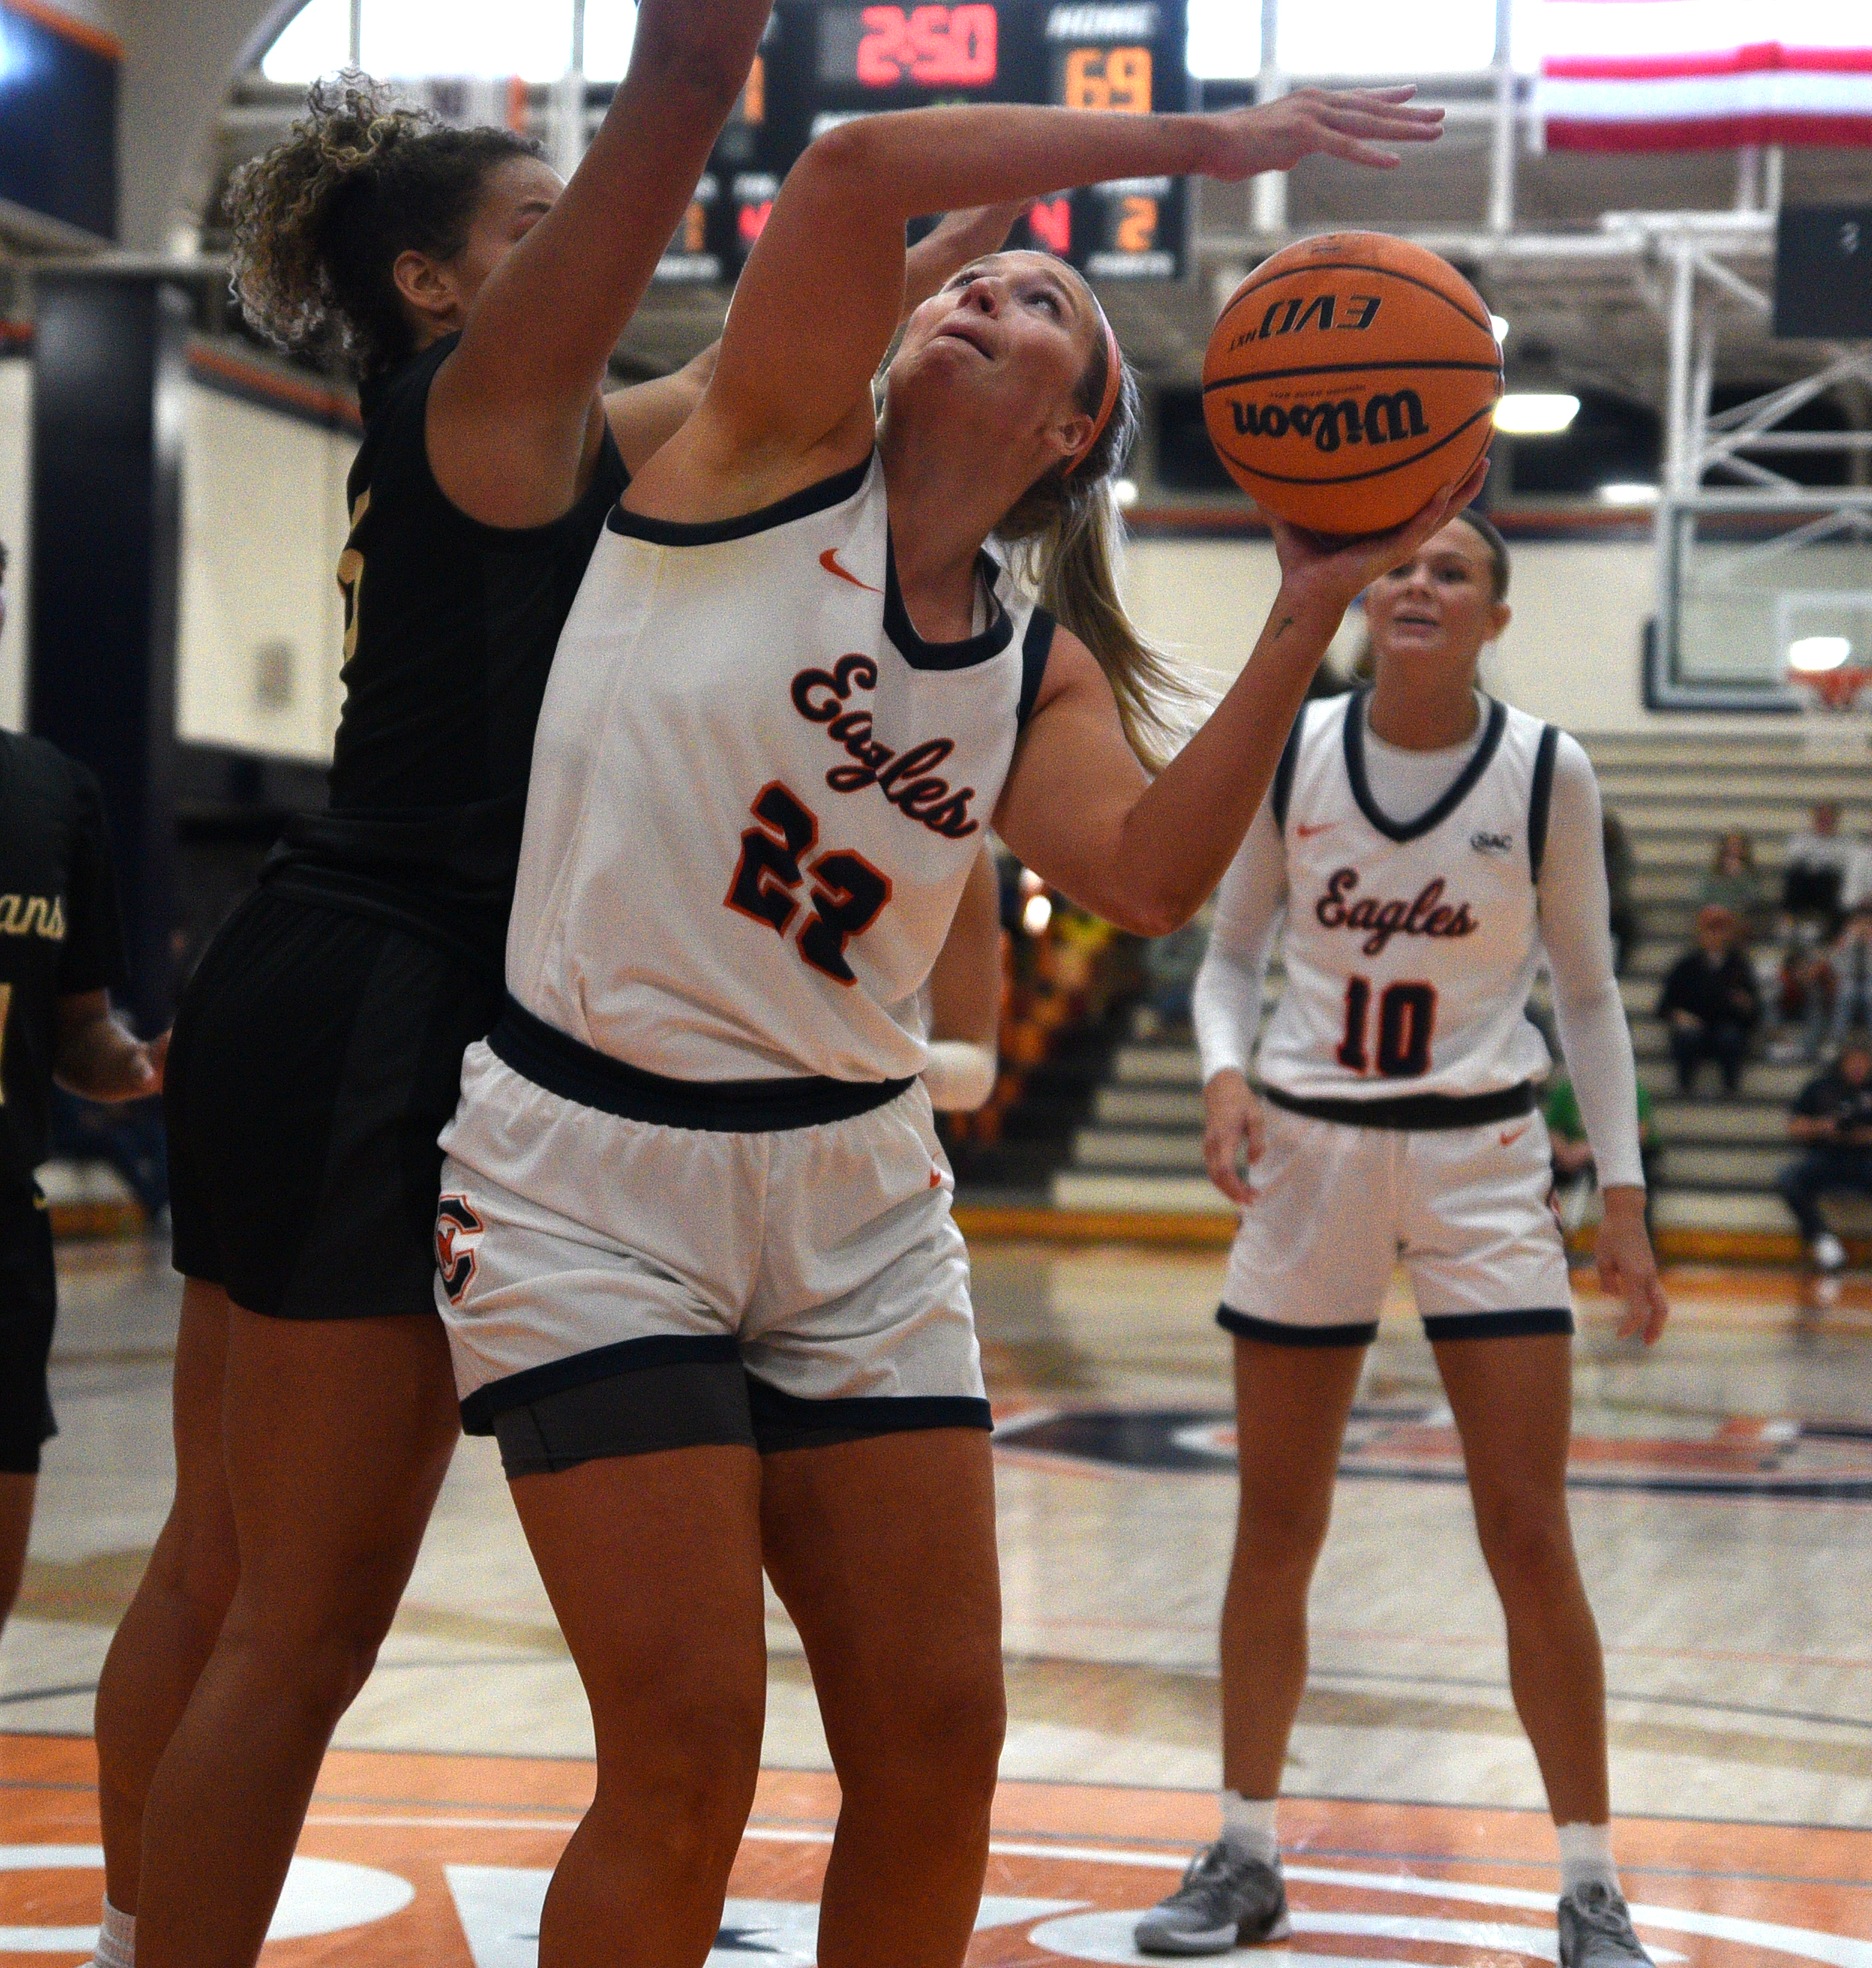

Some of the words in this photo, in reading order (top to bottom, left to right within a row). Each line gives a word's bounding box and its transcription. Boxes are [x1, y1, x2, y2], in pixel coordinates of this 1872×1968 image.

[857, 4, 996, 87] 2:50
[1065, 46, 1152, 113] 69
[1117, 196, 1158, 251] 2
[1258, 294, 1382, 340] EVO
[1230, 387, 1430, 453] Wilson
[790, 653, 979, 839] Eagles
[1316, 867, 1479, 956] Eagles
[1336, 975, 1438, 1078] 10
